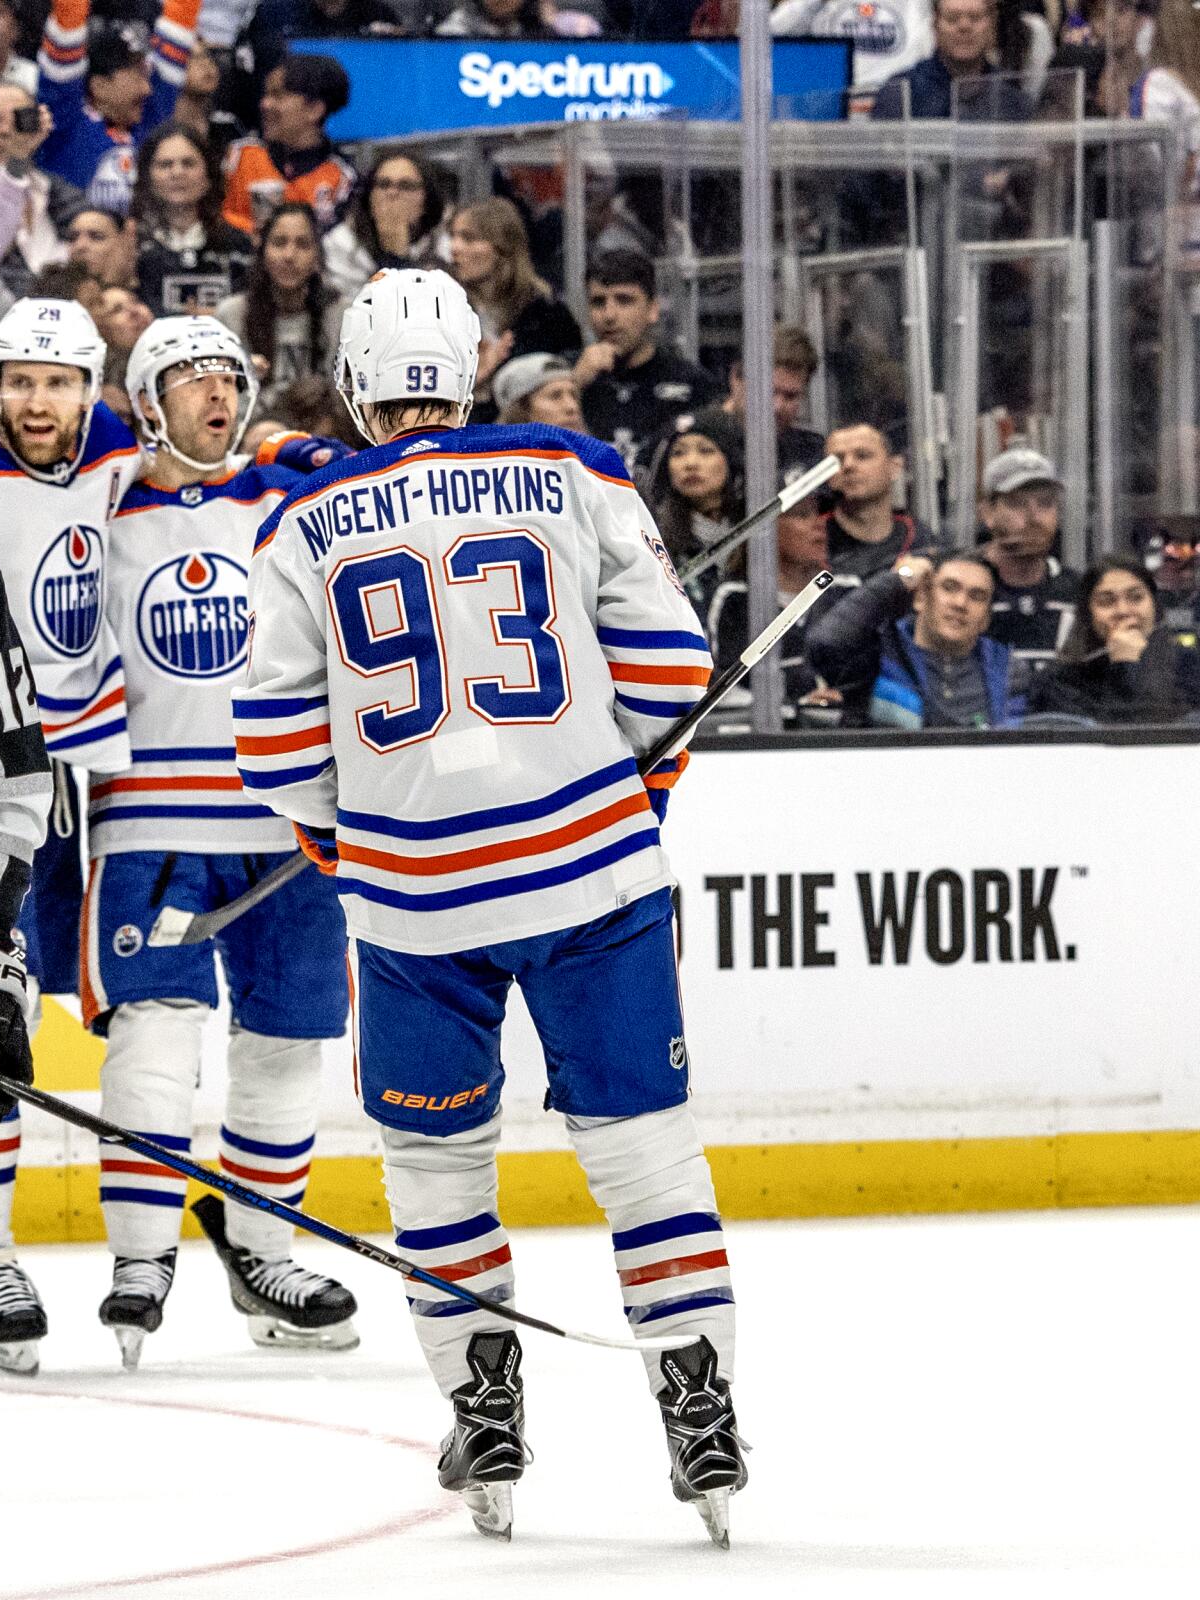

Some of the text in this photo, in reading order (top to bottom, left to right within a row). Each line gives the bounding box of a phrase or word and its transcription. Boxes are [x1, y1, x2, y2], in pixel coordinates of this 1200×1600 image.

[458, 51, 663, 108] Spectrum
[406, 365, 438, 392] 93
[297, 466, 564, 562] NUGENT-HOPKINS
[150, 595, 249, 639] OILERS
[326, 529, 572, 754] 93
[704, 872, 837, 970] THE
[855, 867, 1077, 967] WORK.
[355, 1242, 415, 1275] TRUE
[504, 1345, 516, 1375] CCM
[666, 1359, 689, 1385] CCM
